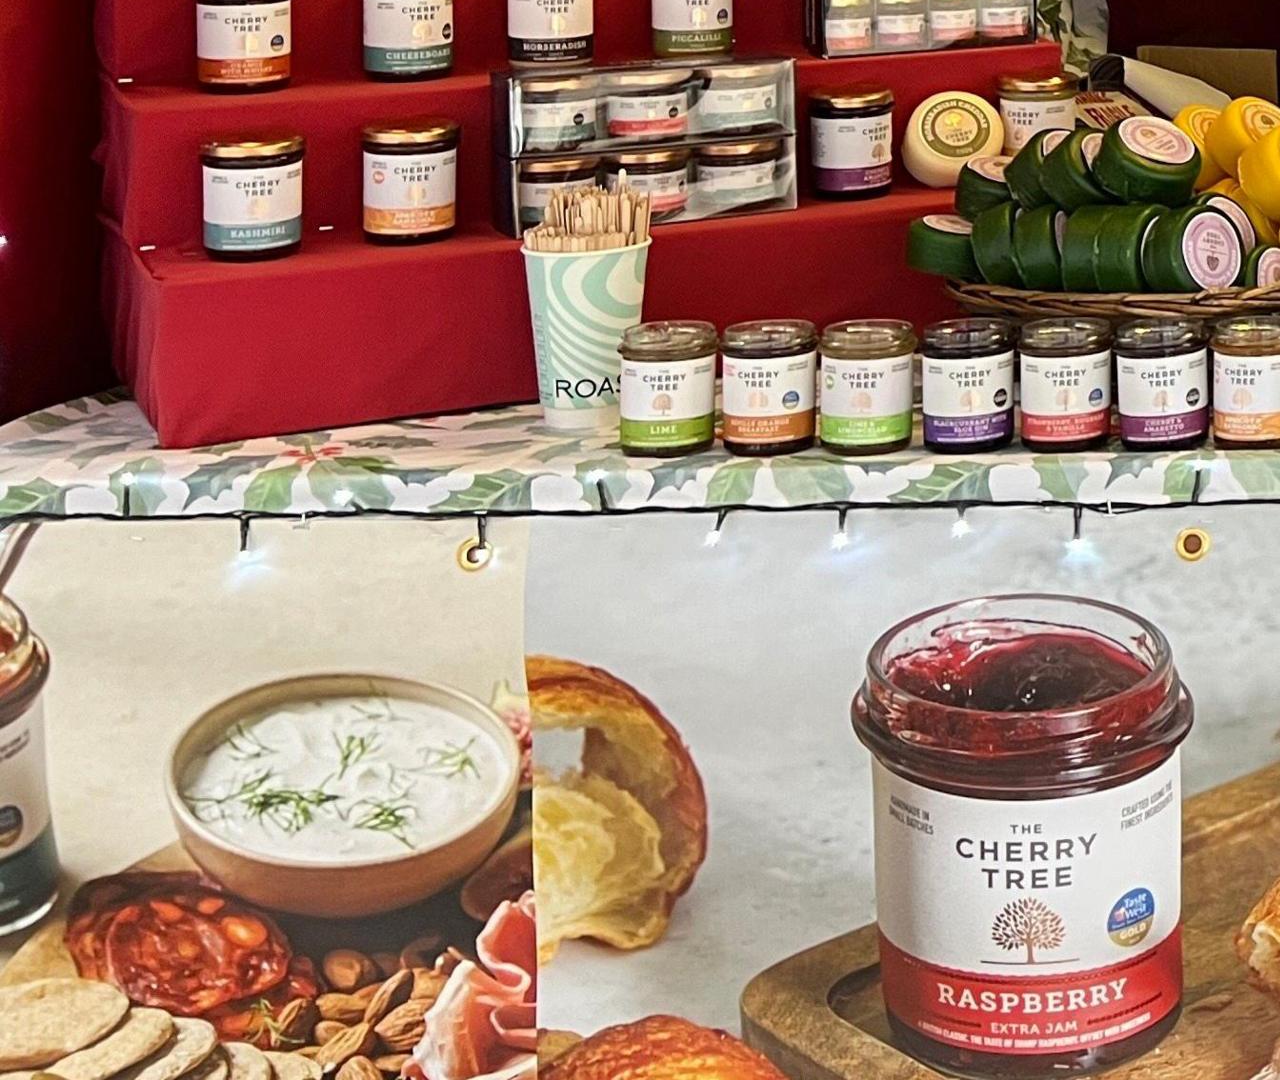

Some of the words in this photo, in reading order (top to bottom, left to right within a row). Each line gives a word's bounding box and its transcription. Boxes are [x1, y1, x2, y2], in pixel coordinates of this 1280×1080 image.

[671, 33, 722, 44] PICCALILLI
[523, 41, 588, 52] HORSERADISH
[235, 179, 282, 189] CHERRY
[244, 188, 274, 196] TREE
[230, 227, 287, 239] KASHMIRI
[642, 373, 687, 384] CHERRY
[650, 382, 679, 392] TREE
[649, 425, 678, 435] LIME
[1010, 824, 1043, 834] THE
[955, 833, 1097, 863] CHERRY
[981, 866, 1073, 889] TREE
[1124, 892, 1147, 909] Taste
[1119, 922, 1147, 941] GOLD
[936, 978, 1128, 1014] RASPBERRY
[990, 1022, 1040, 1035] EXTRA
[1046, 1021, 1078, 1033] JAM
